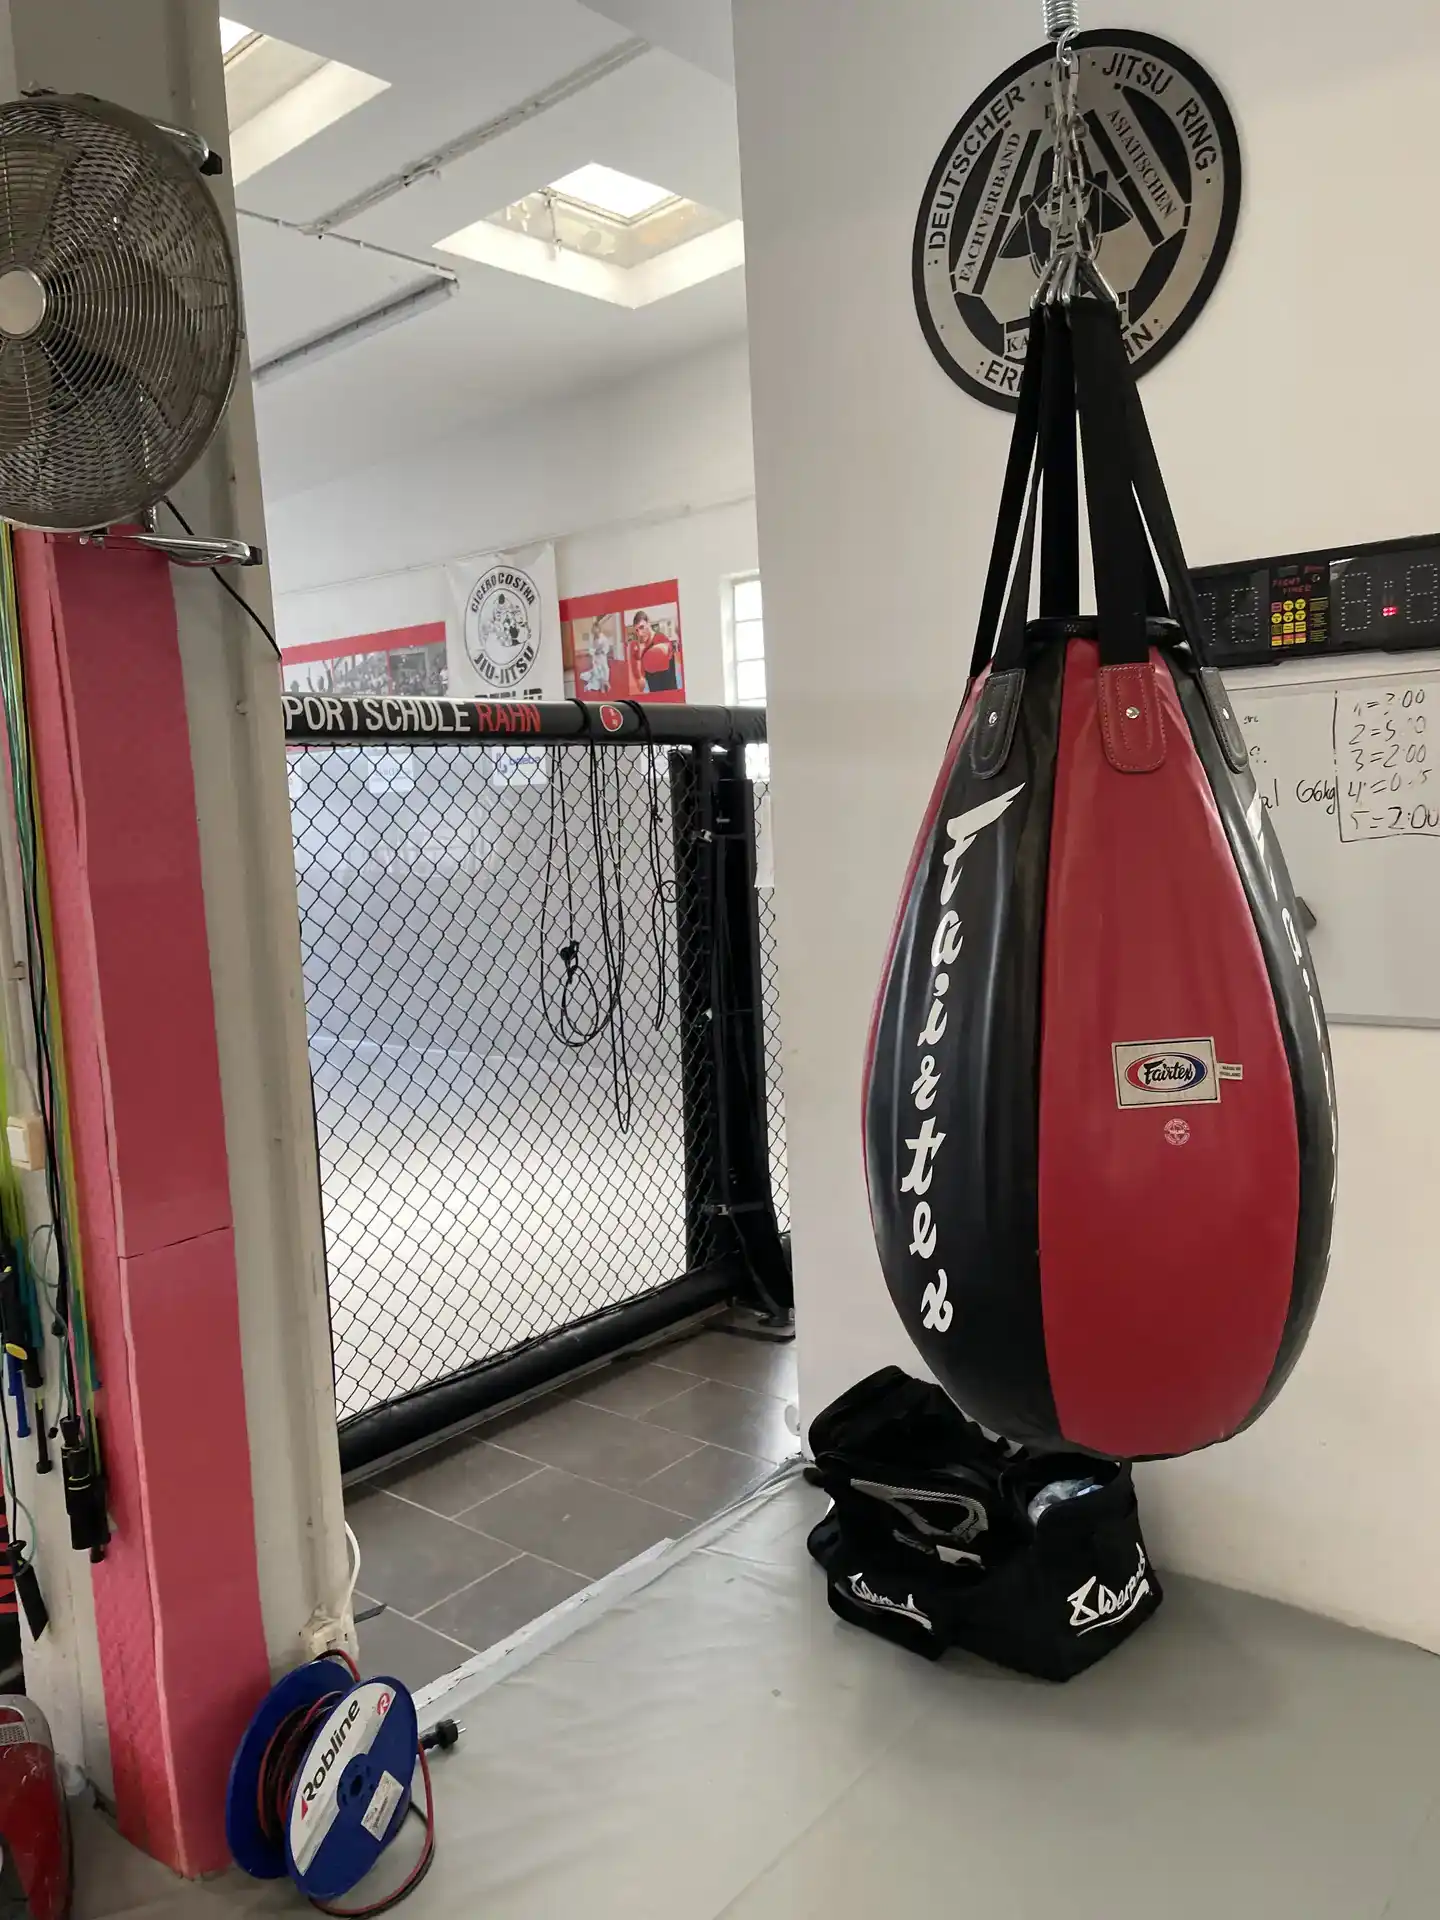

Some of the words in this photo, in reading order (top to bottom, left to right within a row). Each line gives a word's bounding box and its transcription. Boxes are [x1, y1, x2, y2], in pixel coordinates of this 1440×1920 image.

[928, 86, 1026, 250] DEUTSCHER
[1102, 53, 1173, 97] JITSU
[1175, 97, 1217, 171] RING
[958, 132, 1022, 283] FACHVERBAND
[1106, 108, 1179, 221] ASIATISCHEN
[473, 645, 535, 685] JIU-JITSU
[477, 703, 542, 732] RAHN
[901, 781, 1026, 1333] Fairtex
[1143, 1058, 1194, 1086] Fairtex
[302, 1699, 360, 1820] Robline
